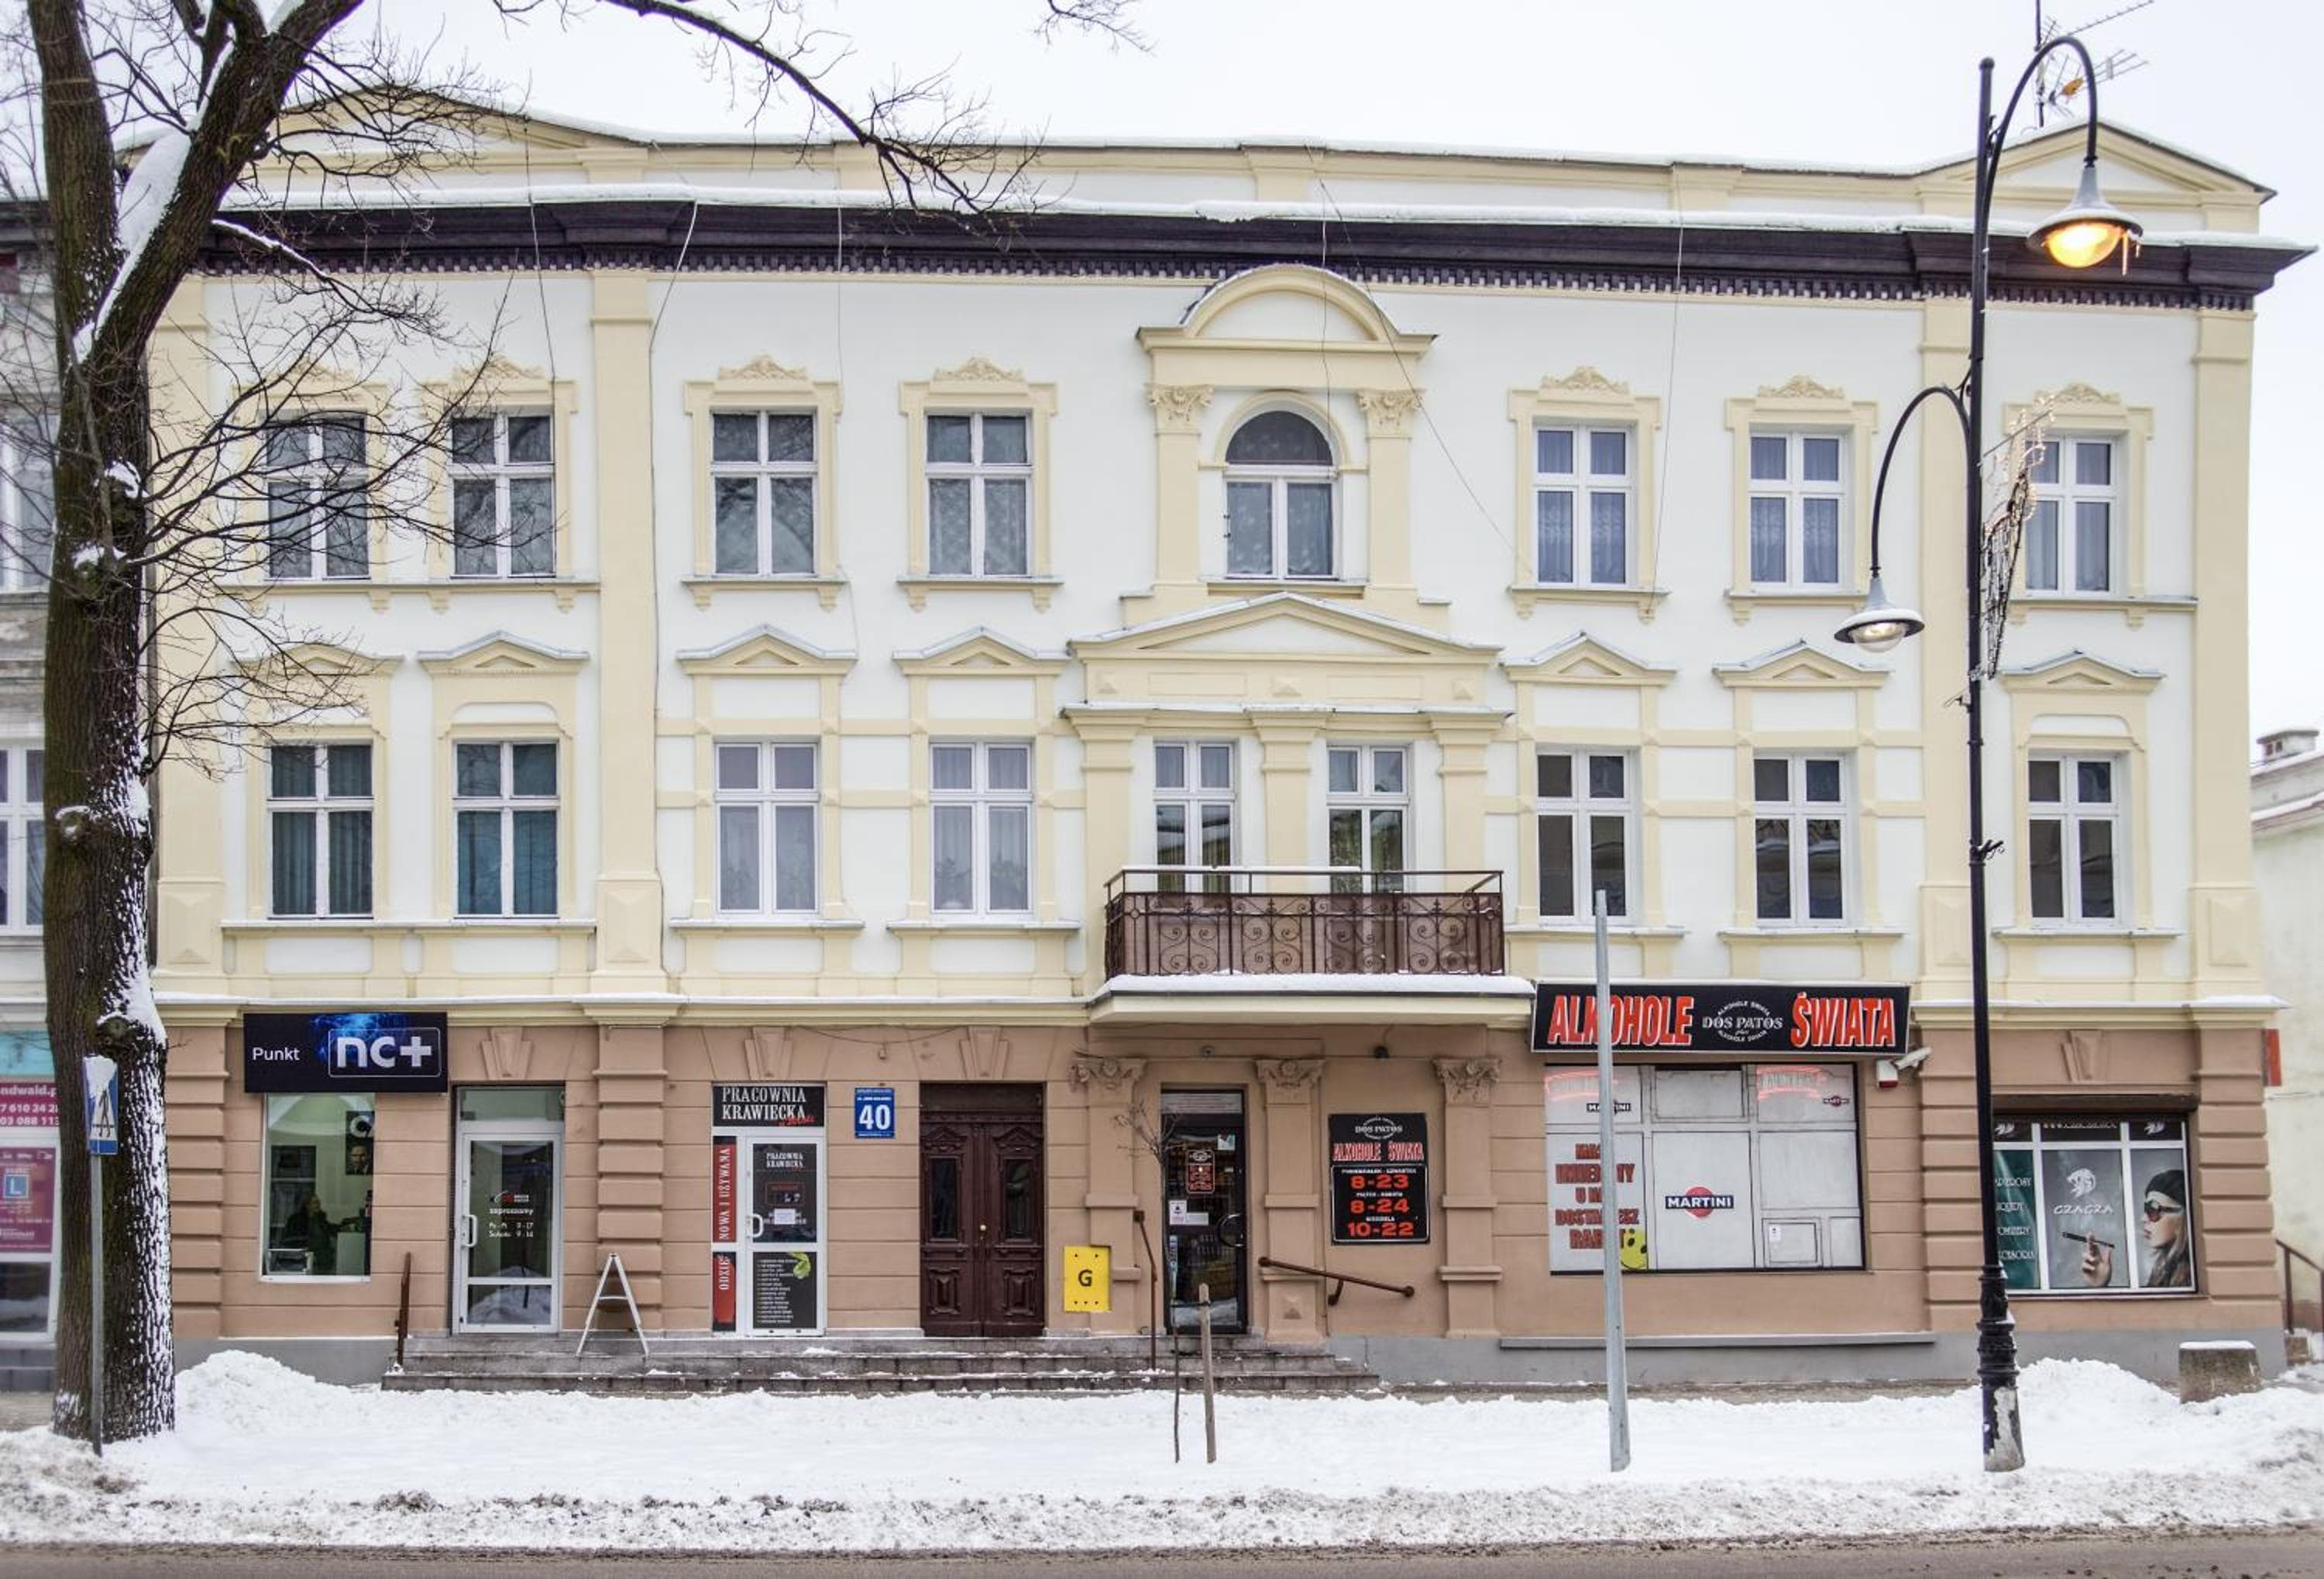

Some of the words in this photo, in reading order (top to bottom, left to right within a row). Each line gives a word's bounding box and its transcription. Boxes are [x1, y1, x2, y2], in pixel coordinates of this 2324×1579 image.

[1702, 1017, 1733, 1029] DOS
[1736, 1017, 1783, 1029] PATOS
[1790, 991, 1896, 1048] ŚWIATA
[253, 1047, 300, 1061] Punkt
[337, 1037, 432, 1068] nc+
[722, 1087, 806, 1103] PRACOWNIA
[722, 1104, 806, 1120] KRAWIECKA
[859, 1105, 891, 1130] 40
[1668, 1197, 1731, 1208] MARTINI
[1078, 1269, 1093, 1287] G
